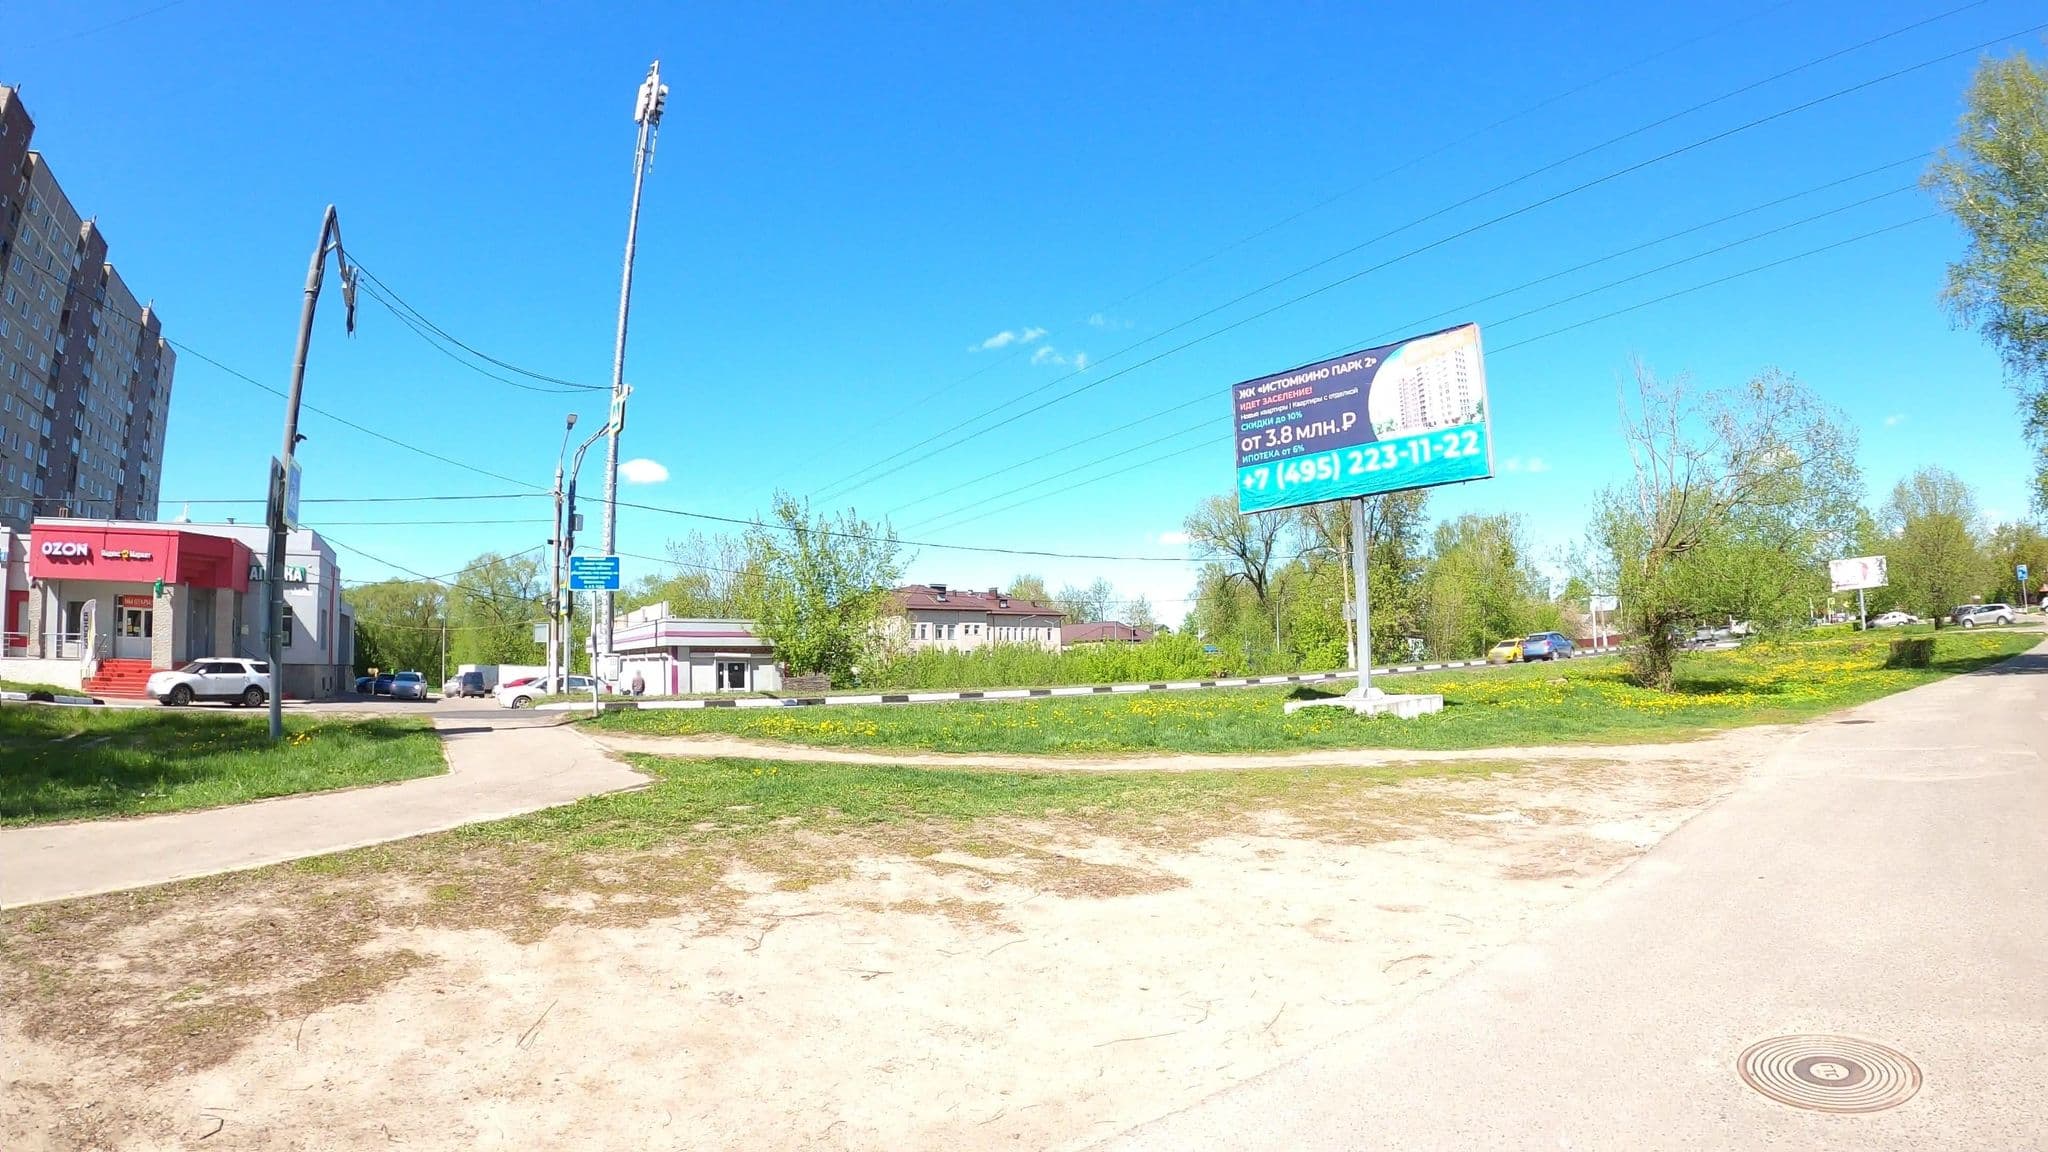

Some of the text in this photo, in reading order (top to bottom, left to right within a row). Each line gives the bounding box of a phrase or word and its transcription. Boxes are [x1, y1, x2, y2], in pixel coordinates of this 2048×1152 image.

[1240, 357, 1377, 399] ЖК «ИСТОМКИНО ПАРК 2»
[1240, 387, 1313, 411] ИДЕТ ЗАСЕЛЕНИЕ!
[1240, 412, 1259, 421] Новые
[1260, 405, 1289, 417] квартиры
[1292, 397, 1322, 409] Квартиры
[1241, 411, 1303, 431] СКИДКИ до 10%
[1242, 444, 1305, 464] ИПОТЕКА от 6%
[1242, 430, 1480, 490] +7 (495) 223-11-22
[41, 541, 88, 556] OZON
